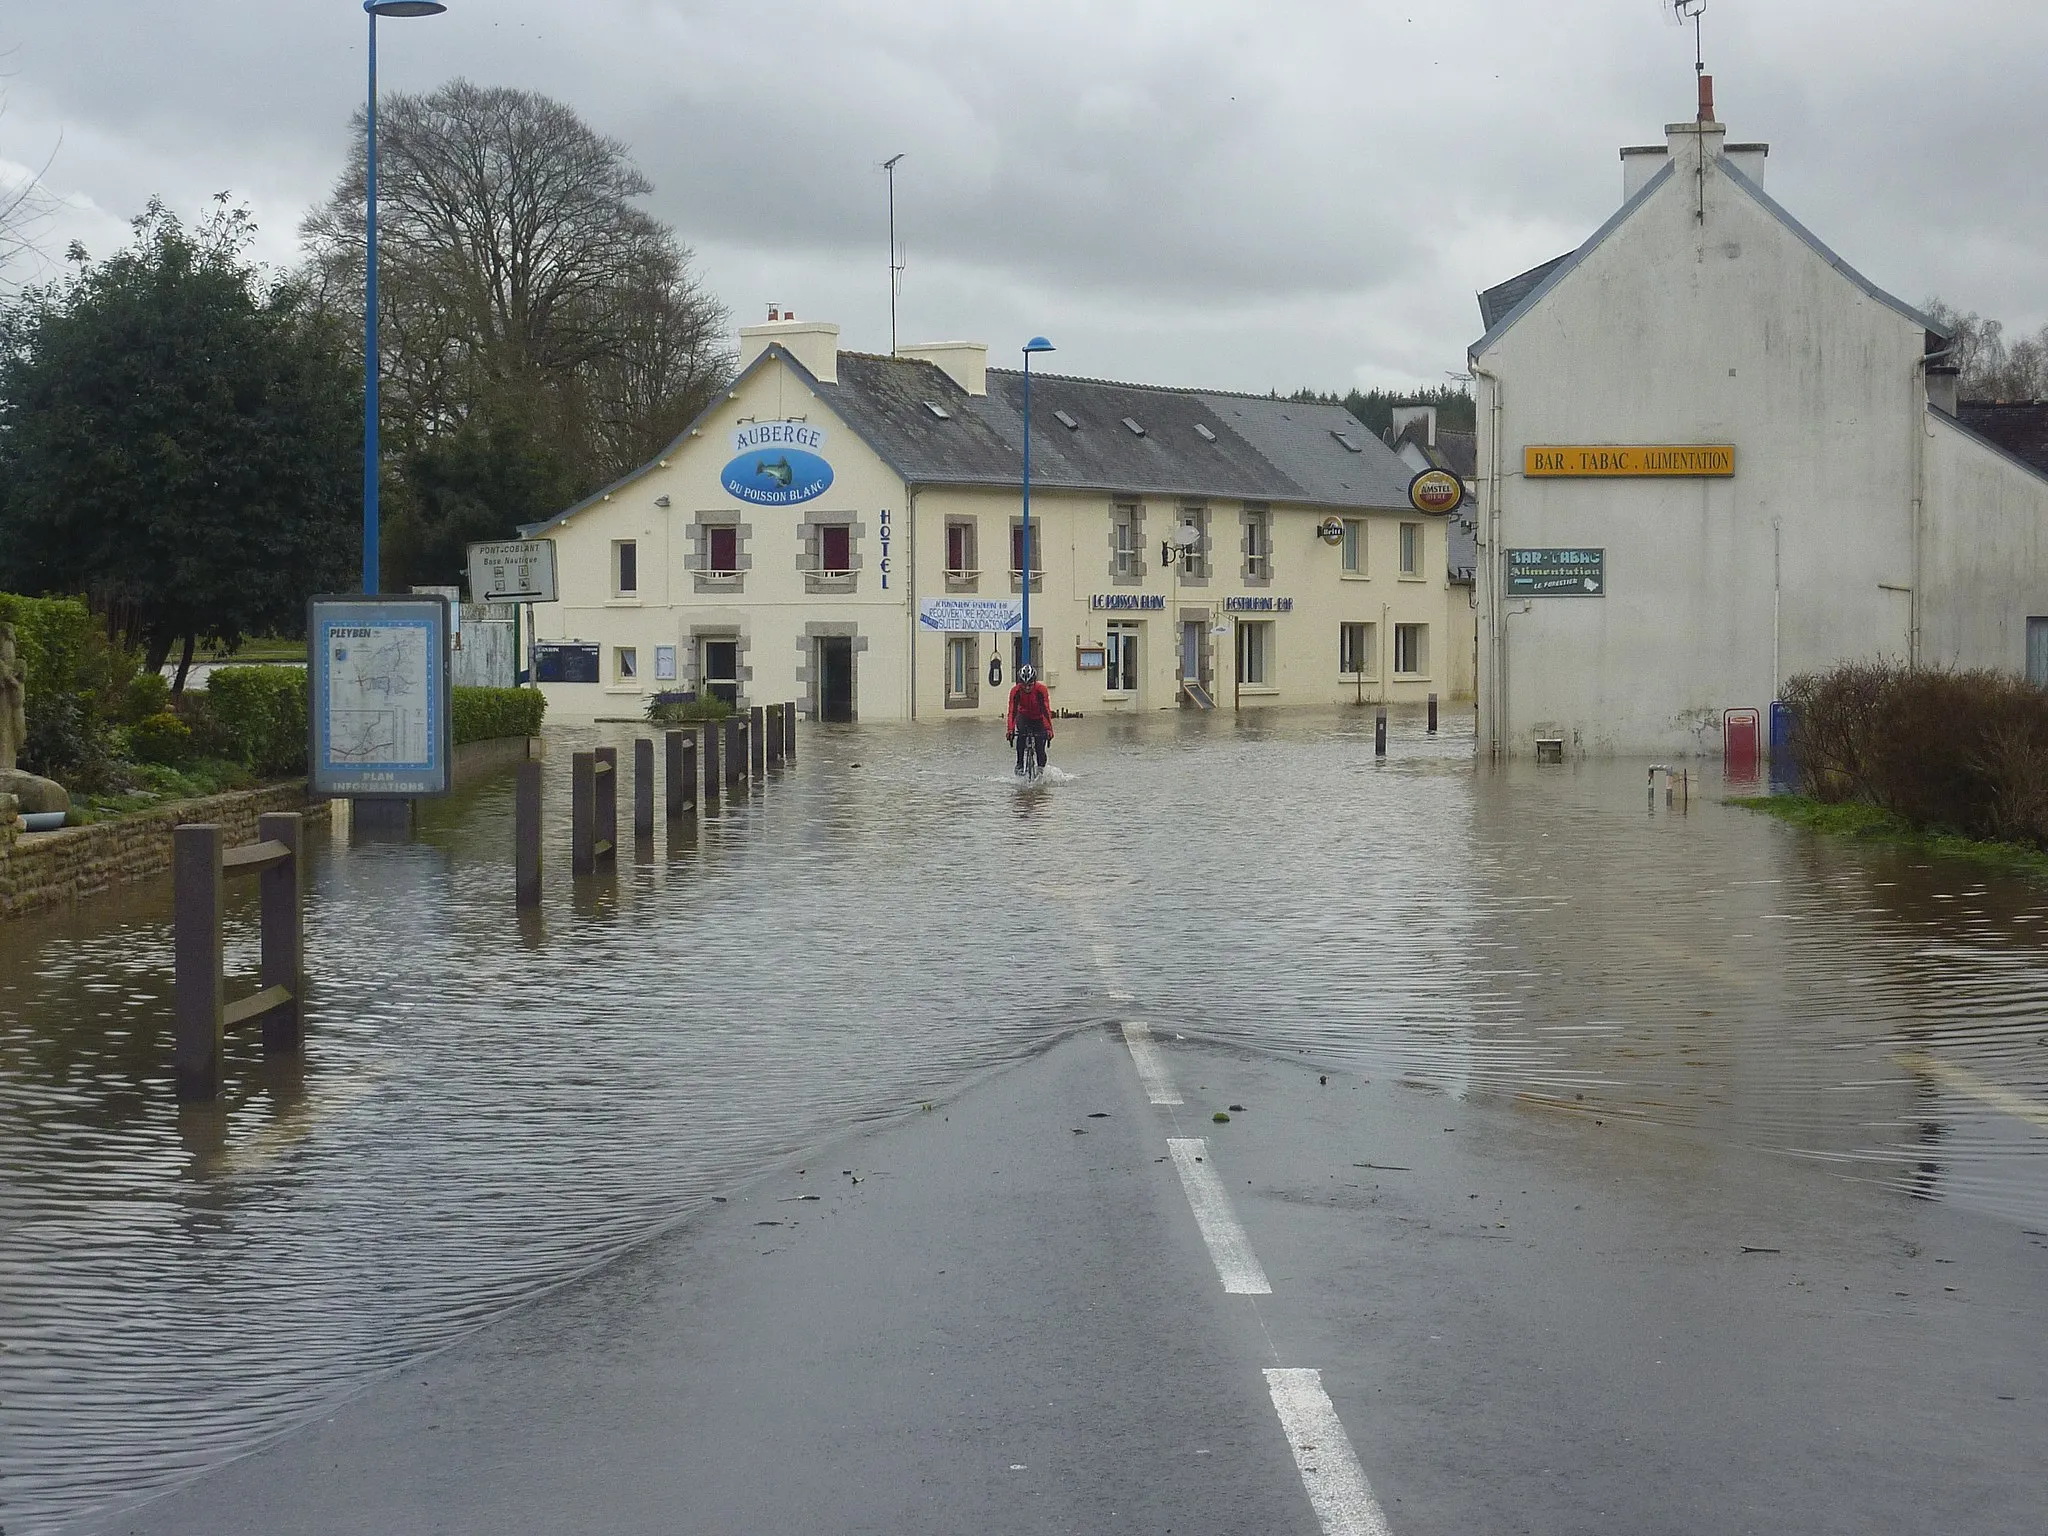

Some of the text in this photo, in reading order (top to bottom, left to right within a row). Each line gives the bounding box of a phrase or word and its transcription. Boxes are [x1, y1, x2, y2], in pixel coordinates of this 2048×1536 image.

[737, 425, 821, 450] AUBERGE
[1534, 452, 1565, 470] BAR
[1579, 451, 1630, 470] TABAC
[1643, 451, 1729, 470] ALIMENTATION
[729, 479, 825, 502] DU POISSON BLANC
[1421, 484, 1452, 494] AMSTEL
[880, 509, 891, 590] HOTEL
[483, 556, 538, 566] Base Nautique
[1511, 551, 1542, 564] BAR
[1550, 551, 1600, 564] TABAC
[1510, 565, 1600, 577] Alimentation
[1093, 594, 1166, 609] LE POISSON BLANC
[938, 618, 959, 630] SUITE
[962, 618, 1006, 631] INONDATION
[330, 628, 371, 638] PLEYBEN
[362, 772, 394, 781] PLAN
[332, 782, 425, 791] INFORMATIONS
